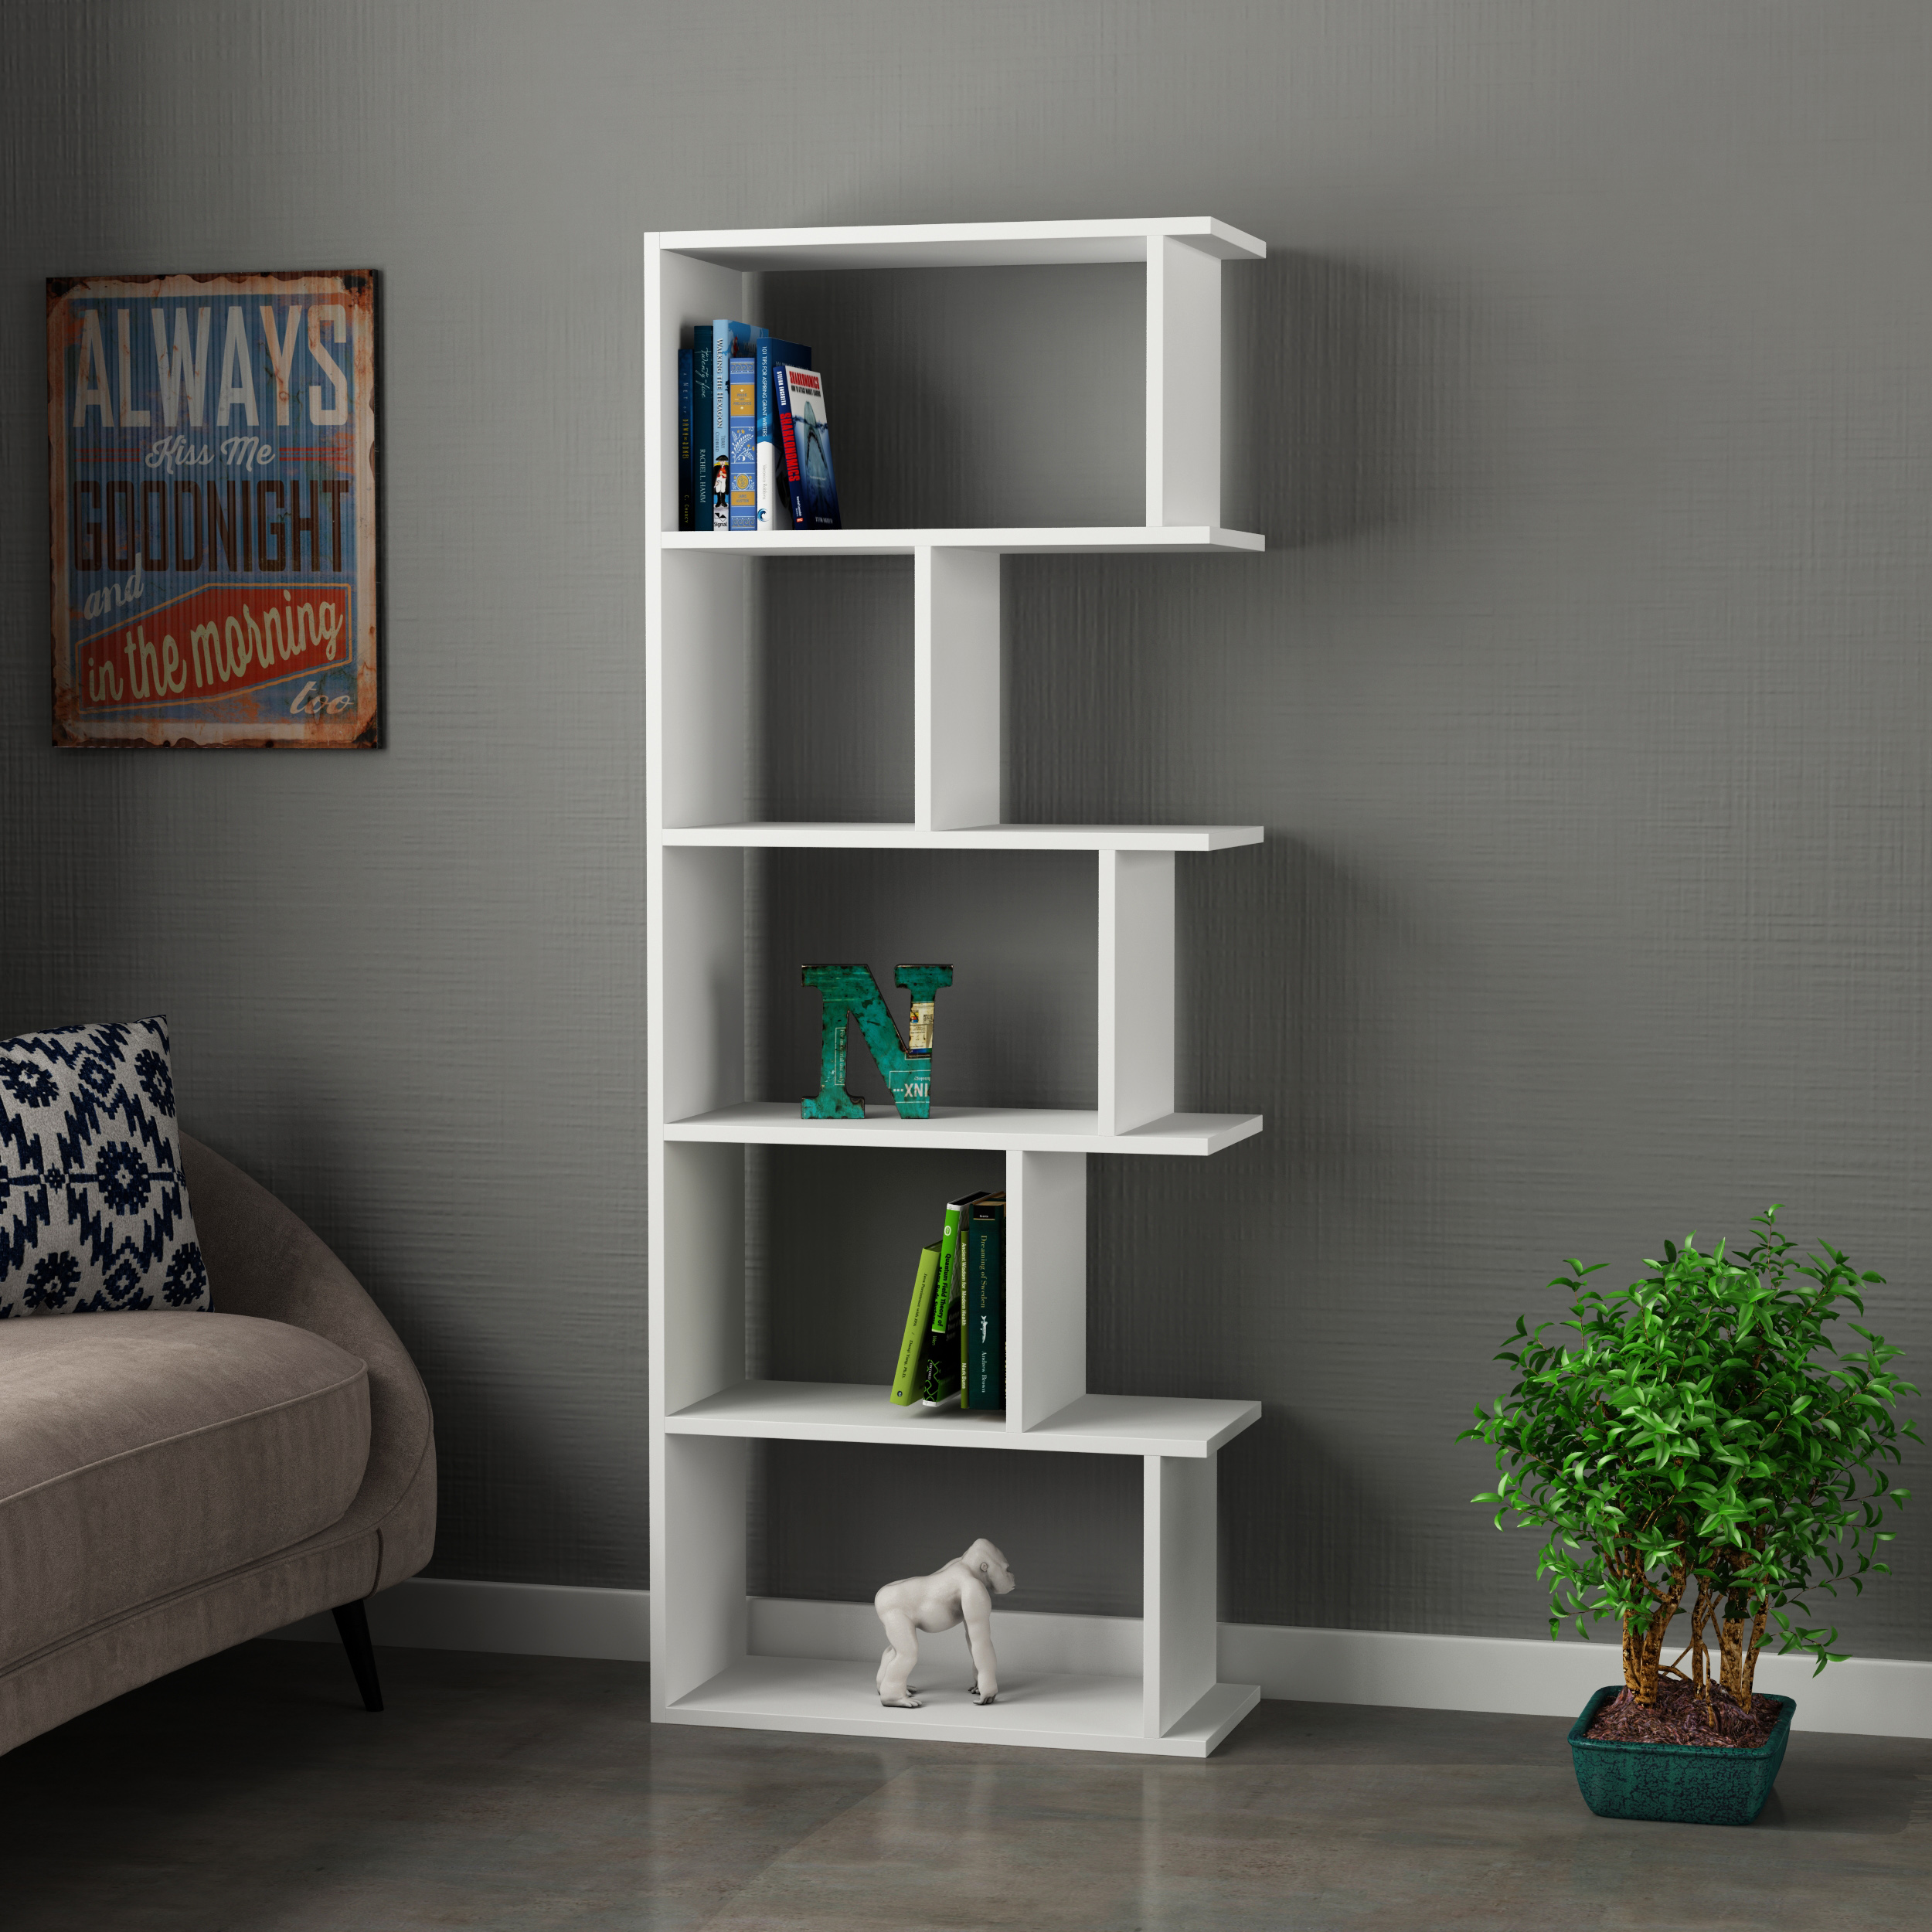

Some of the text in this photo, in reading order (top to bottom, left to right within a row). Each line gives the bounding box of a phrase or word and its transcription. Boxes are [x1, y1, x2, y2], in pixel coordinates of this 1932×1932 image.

[73, 304, 349, 427] ALWAYS
[145, 434, 275, 474] Kiss Me
[780, 412, 801, 482] SHARKONOMICS
[73, 479, 349, 573] GOODNIGHT
[83, 552, 145, 621] and
[87, 590, 344, 702] in the morning
[289, 681, 354, 715] too
[943, 1253, 951, 1281] Quantum
[978, 1235, 988, 1270] Dreaming
[981, 1271, 988, 1280] of
[917, 1284, 926, 1308] Persistence
[937, 1299, 946, 1318] Theory
